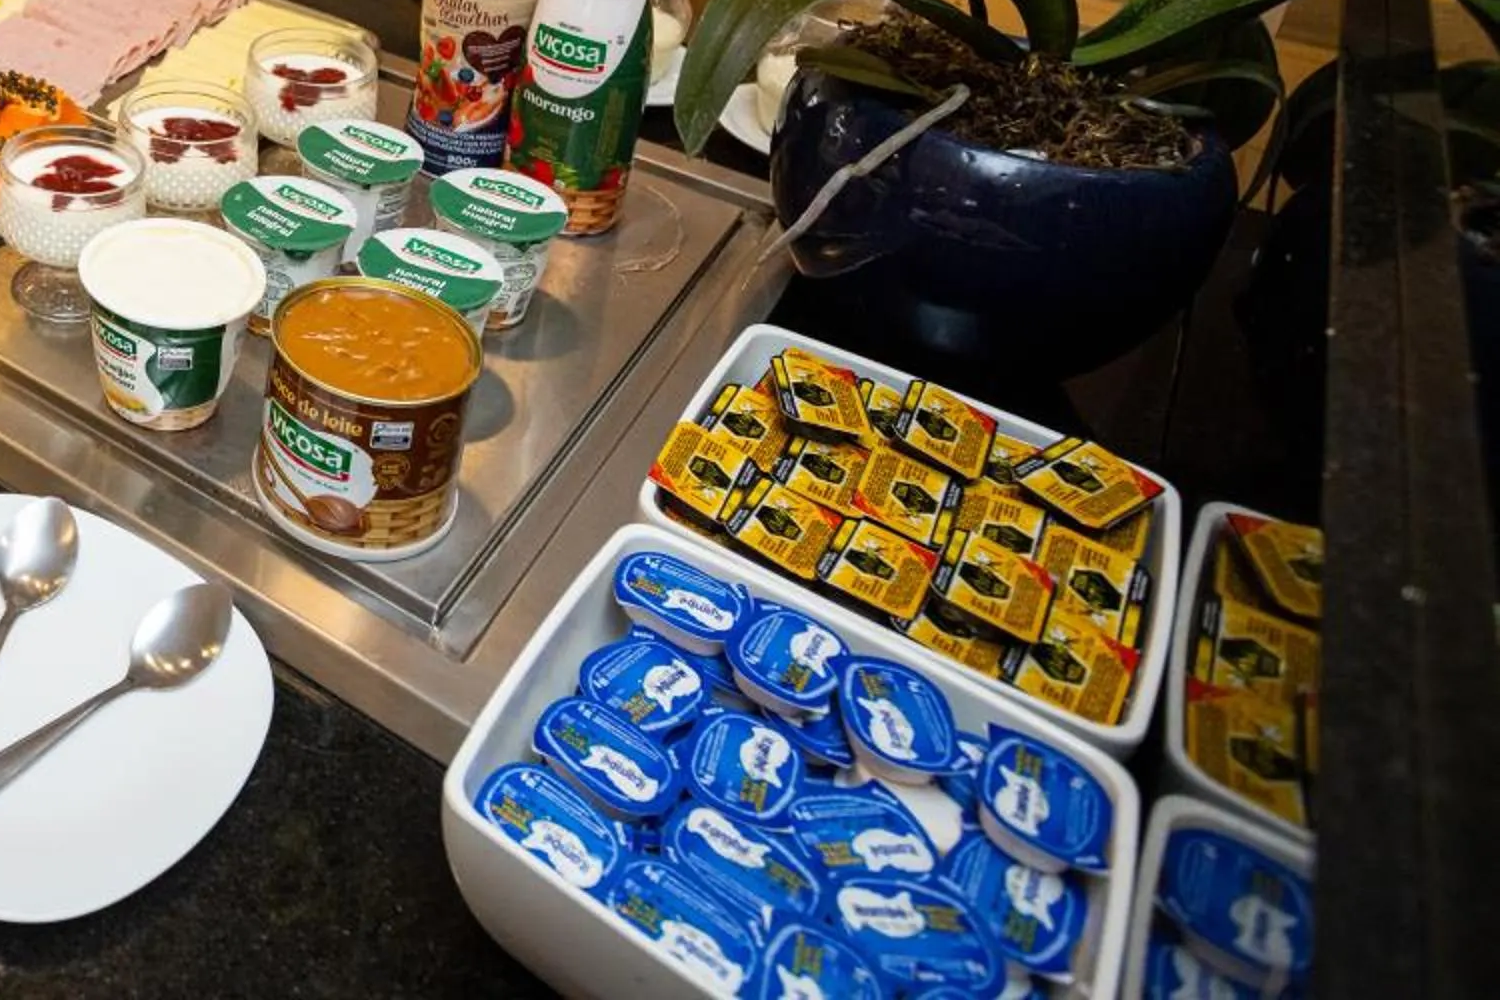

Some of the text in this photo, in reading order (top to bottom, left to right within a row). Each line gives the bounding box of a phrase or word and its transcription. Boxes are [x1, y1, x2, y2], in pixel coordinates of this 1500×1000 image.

[523, 87, 595, 123] morango
[467, 202, 517, 223] natural
[297, 399, 319, 421] de
[322, 410, 364, 438] leite
